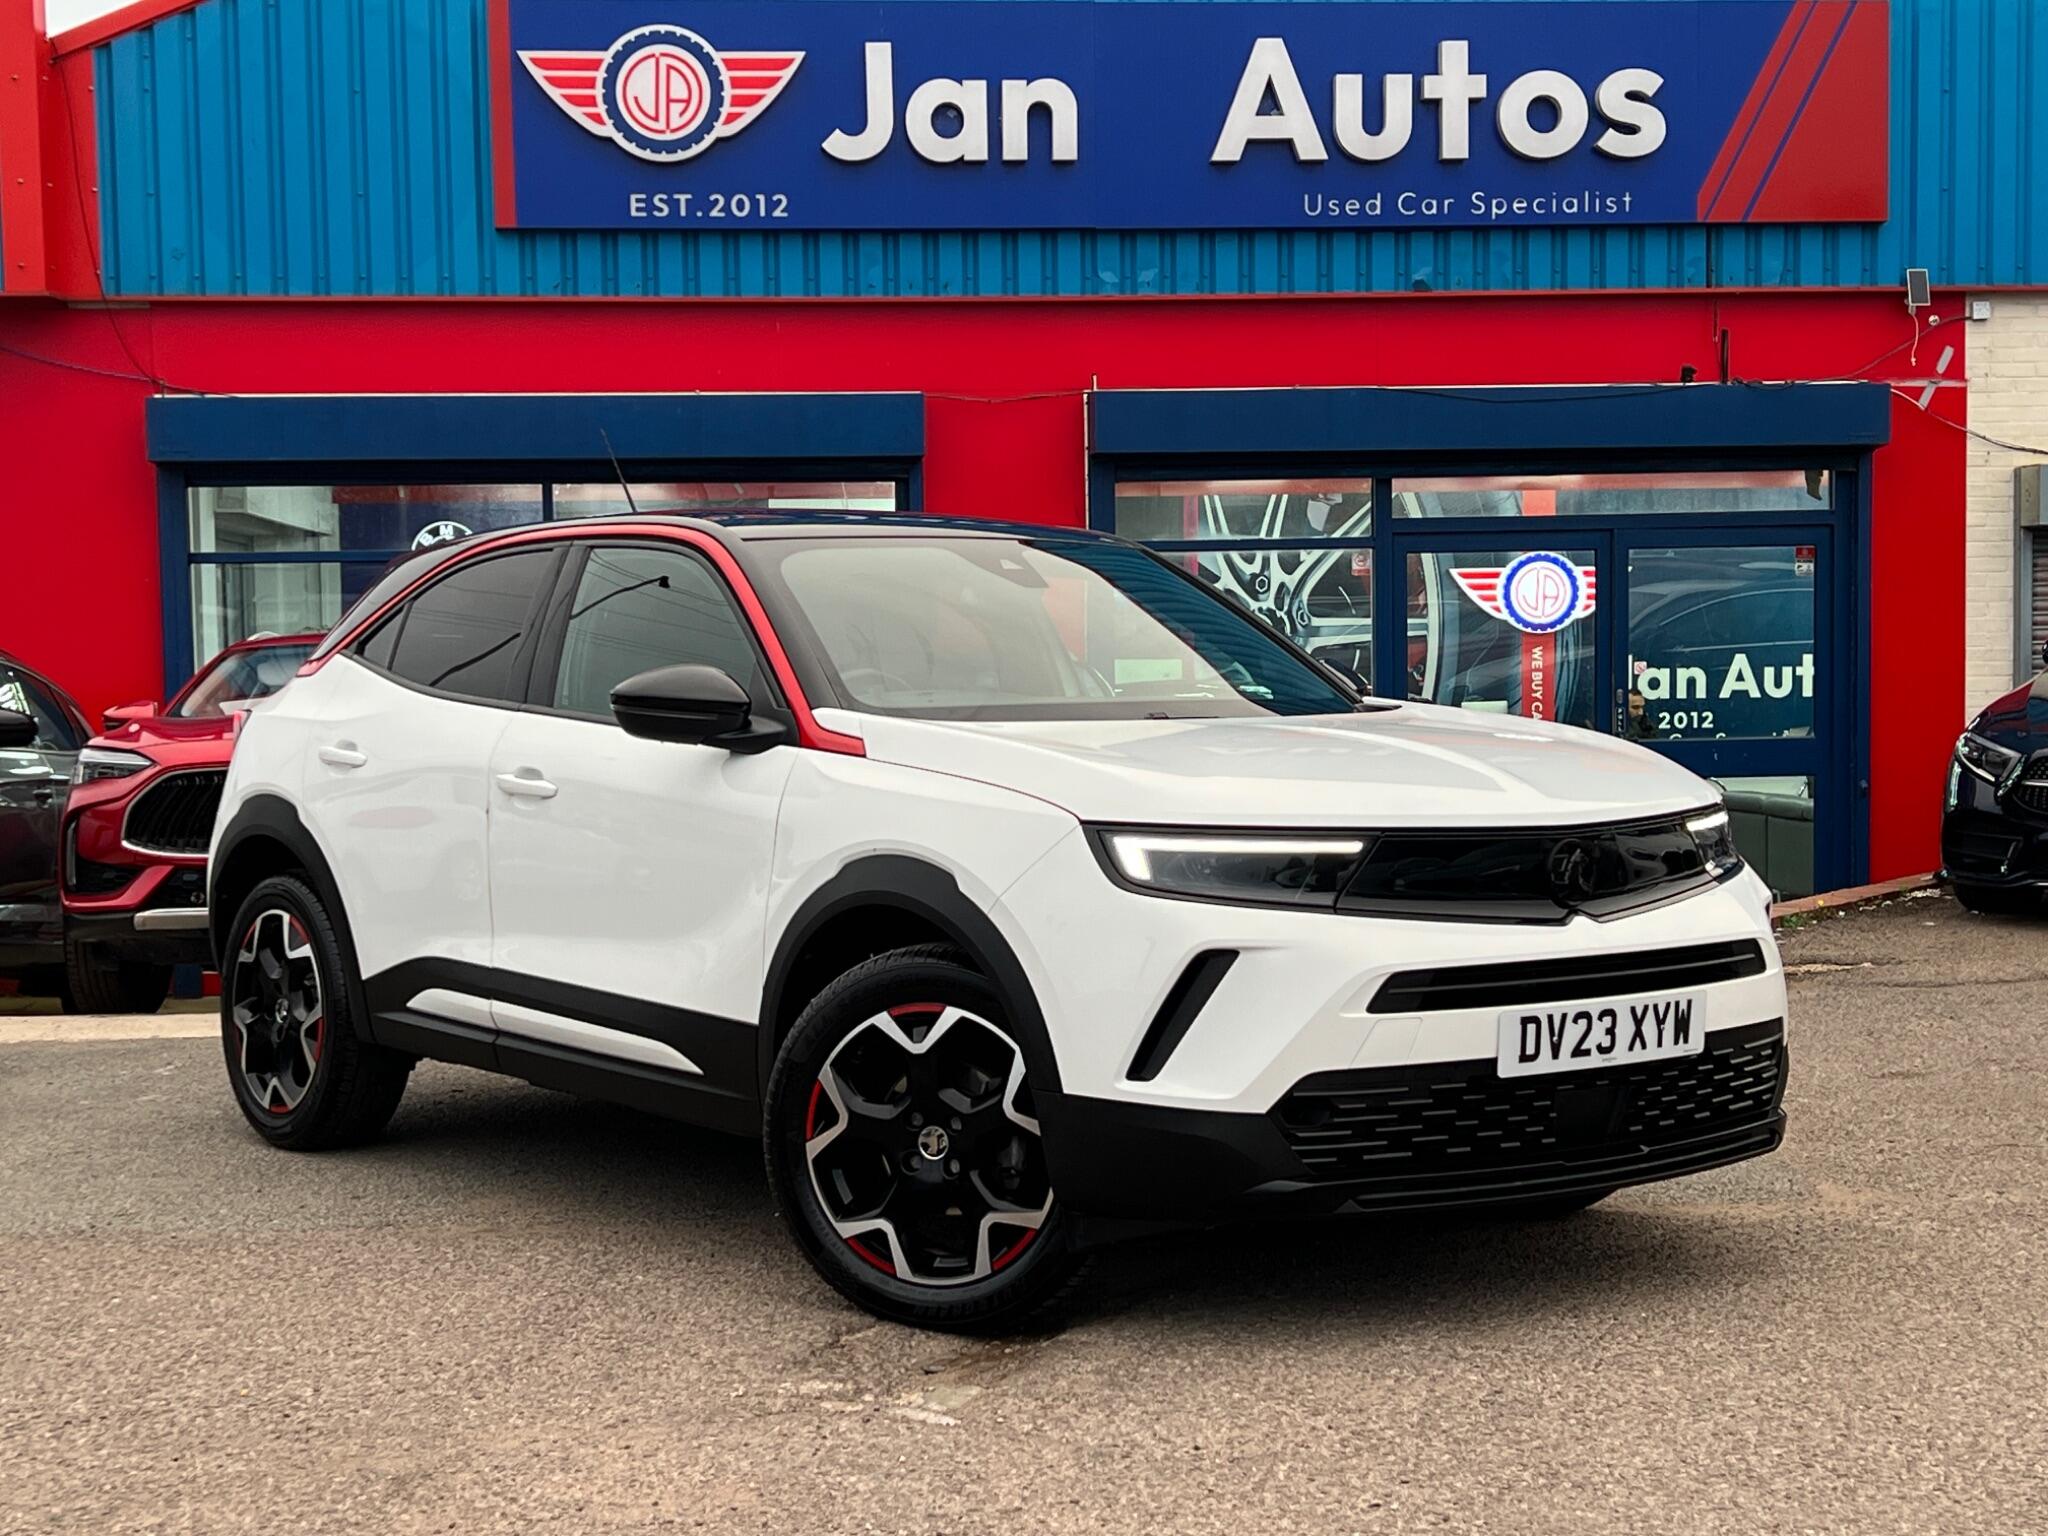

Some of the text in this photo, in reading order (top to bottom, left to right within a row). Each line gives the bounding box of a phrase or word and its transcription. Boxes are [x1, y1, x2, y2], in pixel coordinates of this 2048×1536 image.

[821, 37, 1667, 163] Jan Autos
[629, 193, 789, 218] EST.2012
[1303, 190, 1633, 219] Used Car Specialist
[1531, 646, 1543, 669] WE
[1531, 671, 1543, 700] BUY
[1657, 711, 1714, 729] 2012
[1518, 998, 1693, 1064] DV23 XYW
